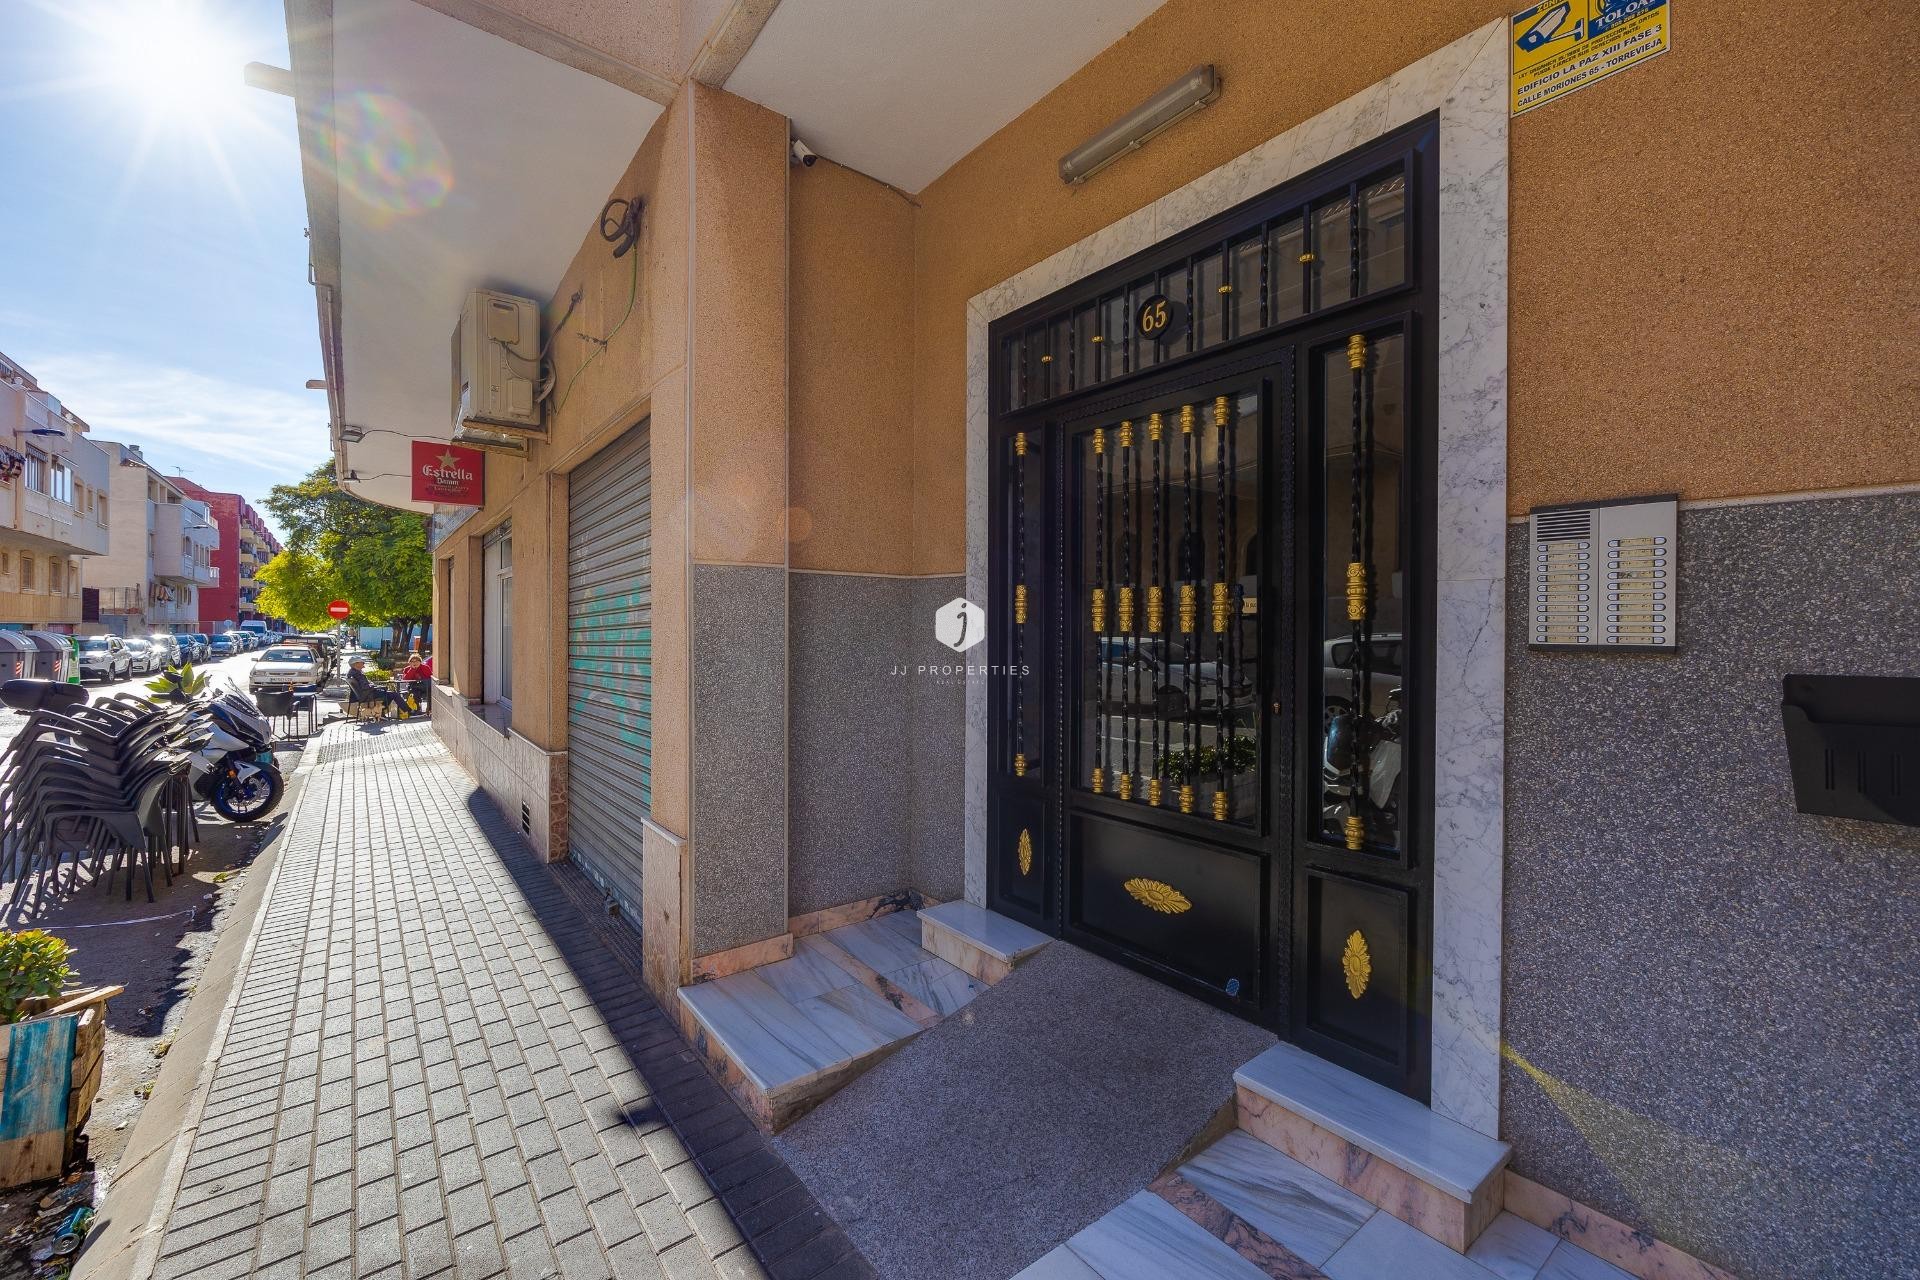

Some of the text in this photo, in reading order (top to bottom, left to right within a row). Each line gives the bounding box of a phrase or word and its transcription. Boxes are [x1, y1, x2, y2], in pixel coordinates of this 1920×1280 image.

[1537, 0, 1561, 13] ZON
[1517, 23, 1662, 95] EDIFICIO LA PAZ XIII FASE 3
[1517, 93, 1542, 108] CALLE
[1543, 72, 1587, 97] MORIONES
[1589, 66, 1600, 76] 65
[1606, 37, 1663, 68] TORREVIEJA
[1142, 300, 1166, 332] 65
[422, 463, 473, 481] Estrella
